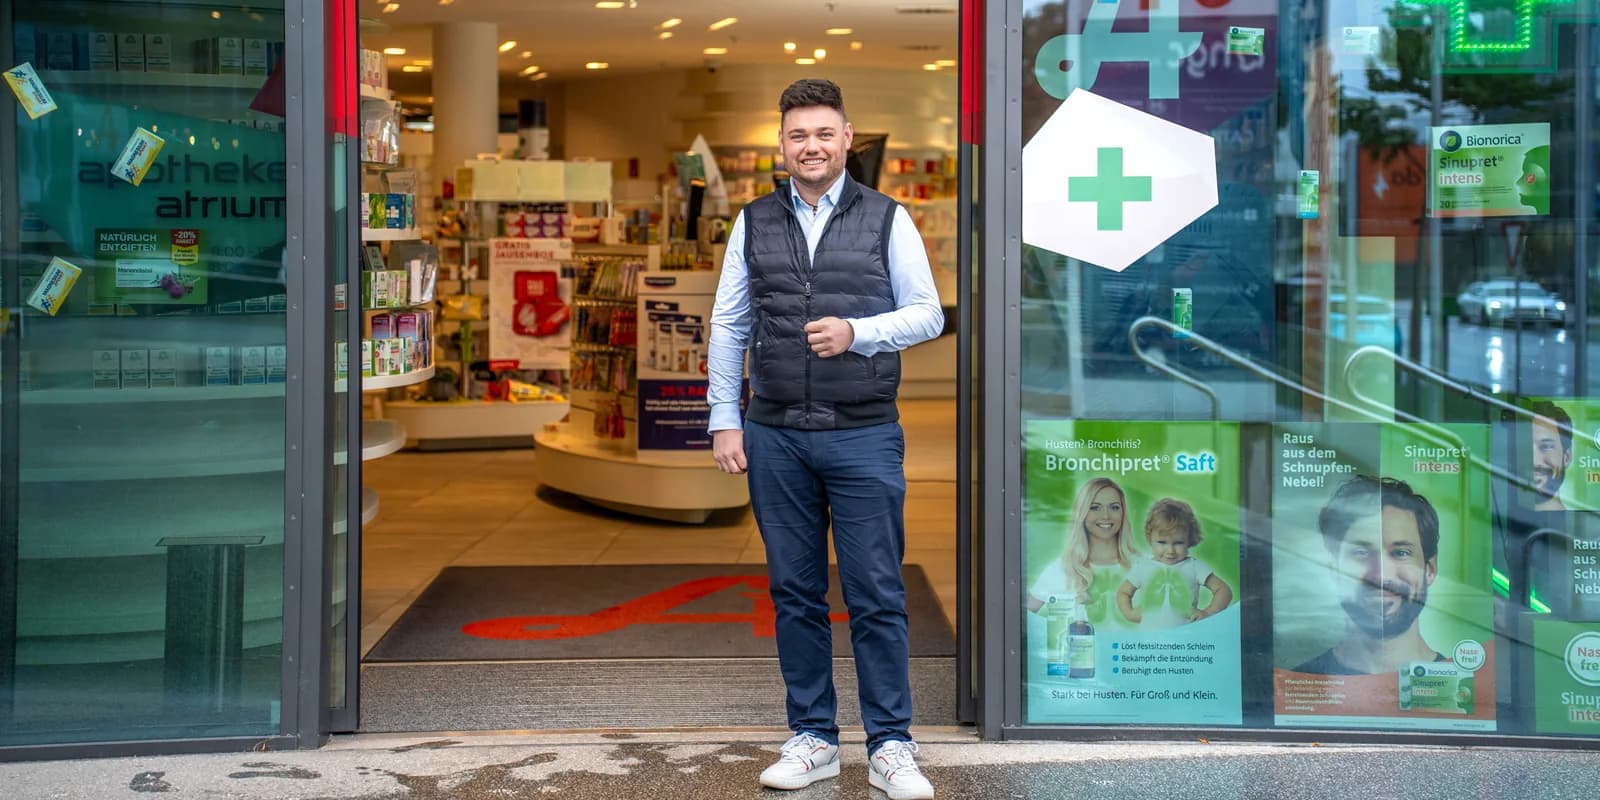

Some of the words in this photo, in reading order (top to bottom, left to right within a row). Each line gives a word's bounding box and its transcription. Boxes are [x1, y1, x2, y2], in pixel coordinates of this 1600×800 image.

[1440, 173, 1481, 184] intens
[100, 231, 157, 242] NATÜRLICH
[174, 231, 197, 239] -20%
[100, 243, 156, 251] ENTGIFTEN
[1283, 433, 1313, 443] Raus
[1045, 439, 1084, 449] Husten?
[1087, 439, 1141, 449] Bronchitis?
[1283, 449, 1305, 458] aus
[1308, 447, 1336, 458] dem
[1176, 454, 1215, 471] Saft
[1414, 459, 1459, 472] intens
[1282, 461, 1357, 475] Schnupfen-
[1283, 476, 1324, 487] Nebel!
[1573, 556, 1596, 565] aus
[1574, 568, 1600, 579] Sch
[1137, 642, 1185, 650] festsitzenden
[1187, 642, 1215, 650] Schleim
[1121, 655, 1155, 664] Bekämpft
[1170, 655, 1213, 664] Entzündung
[1122, 667, 1151, 676] Beruhigt
[1051, 690, 1074, 699] Stark
[1076, 690, 1091, 699] bei
[1093, 690, 1128, 699] Husten.
[1131, 690, 1144, 699] Für
[1147, 690, 1170, 699] Groß
[1172, 690, 1190, 699] und
[1193, 690, 1218, 700] Klein.
